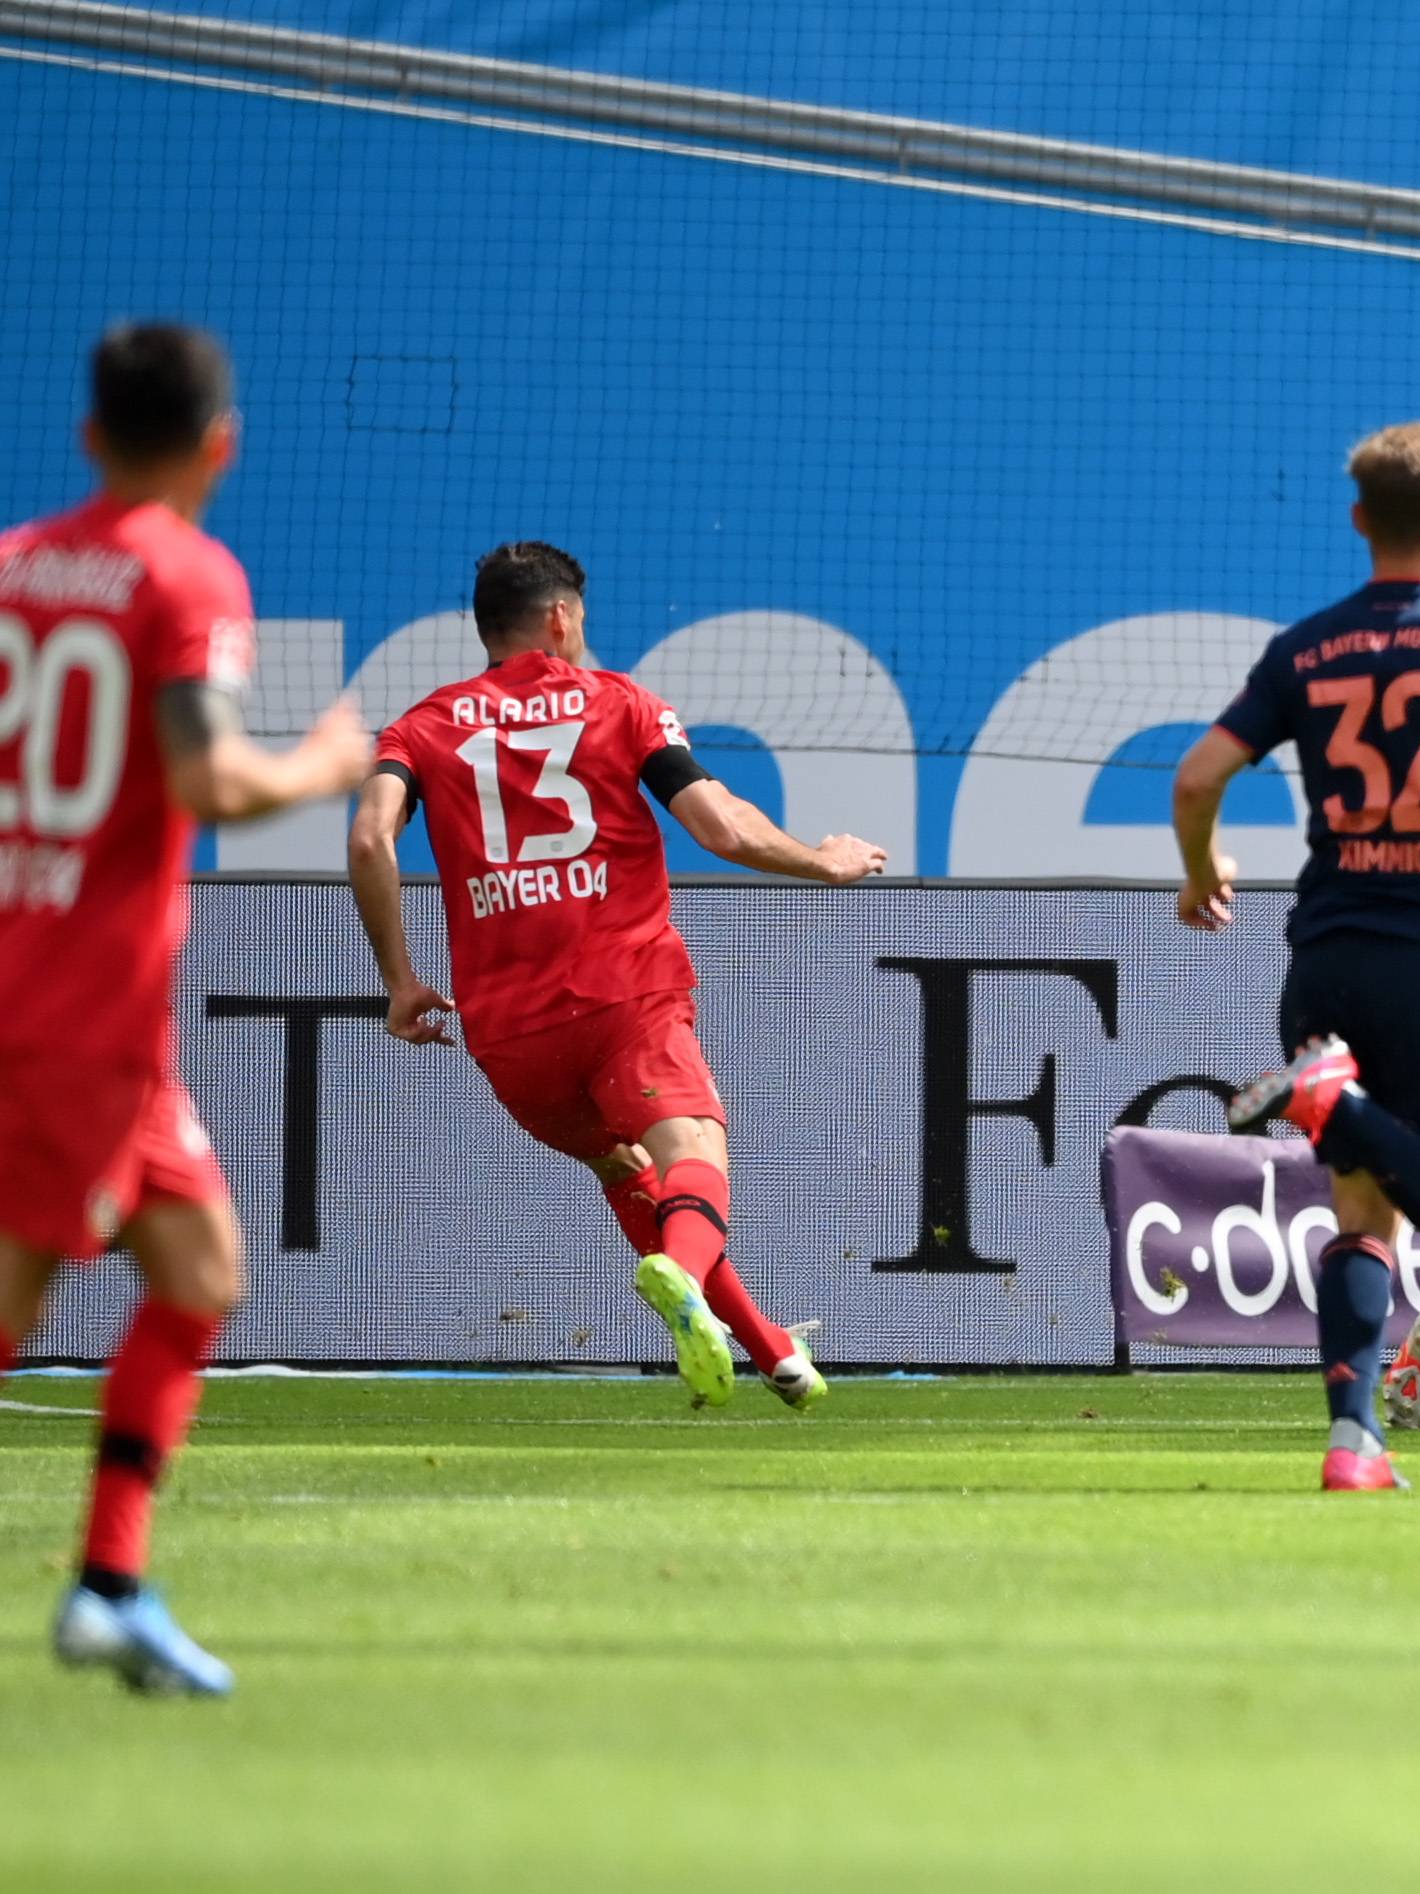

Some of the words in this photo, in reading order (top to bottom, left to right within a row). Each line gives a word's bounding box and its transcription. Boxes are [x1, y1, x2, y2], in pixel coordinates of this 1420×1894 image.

[452, 689, 585, 725] ALARIO
[454, 721, 597, 863] 13
[467, 865, 562, 919] BAYER
[567, 860, 608, 901] 04
